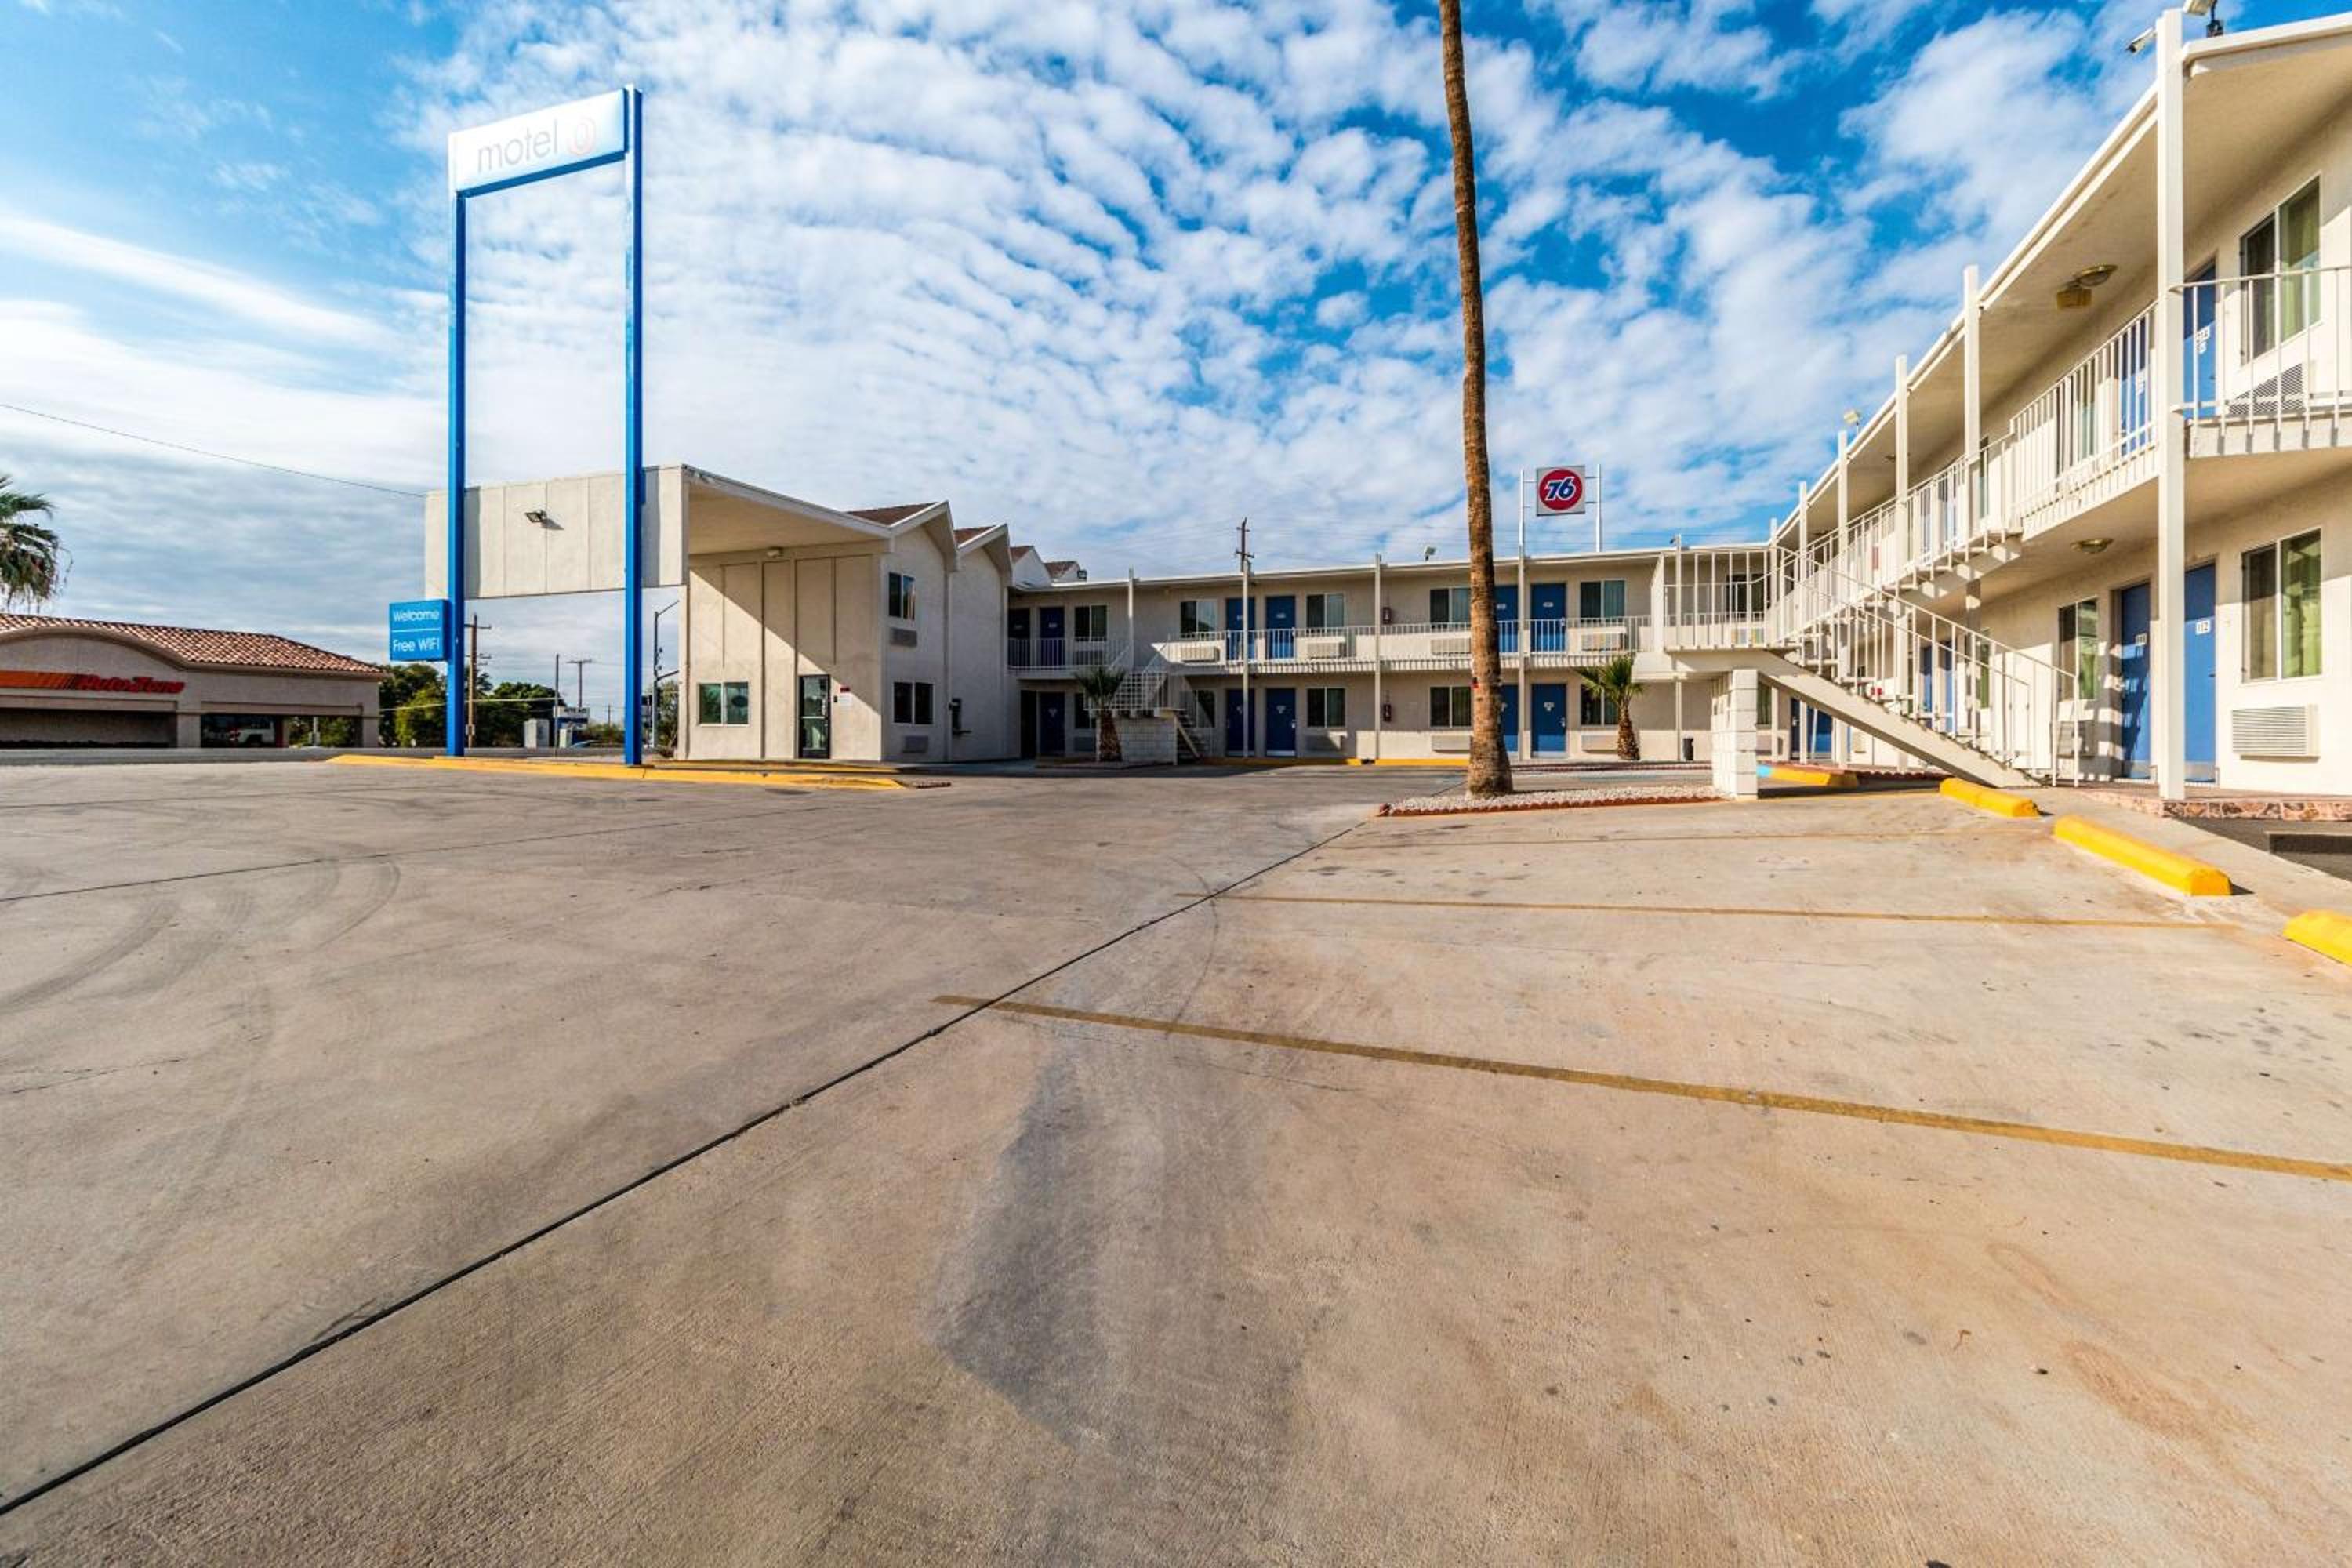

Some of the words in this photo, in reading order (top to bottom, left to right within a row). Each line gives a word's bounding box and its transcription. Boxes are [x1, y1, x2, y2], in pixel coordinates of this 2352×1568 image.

[477, 118, 558, 173] motel
[1544, 476, 1577, 501] 76
[394, 610, 440, 622] Welcome
[393, 639, 416, 652] Free
[76, 673, 186, 694] AutoZone
